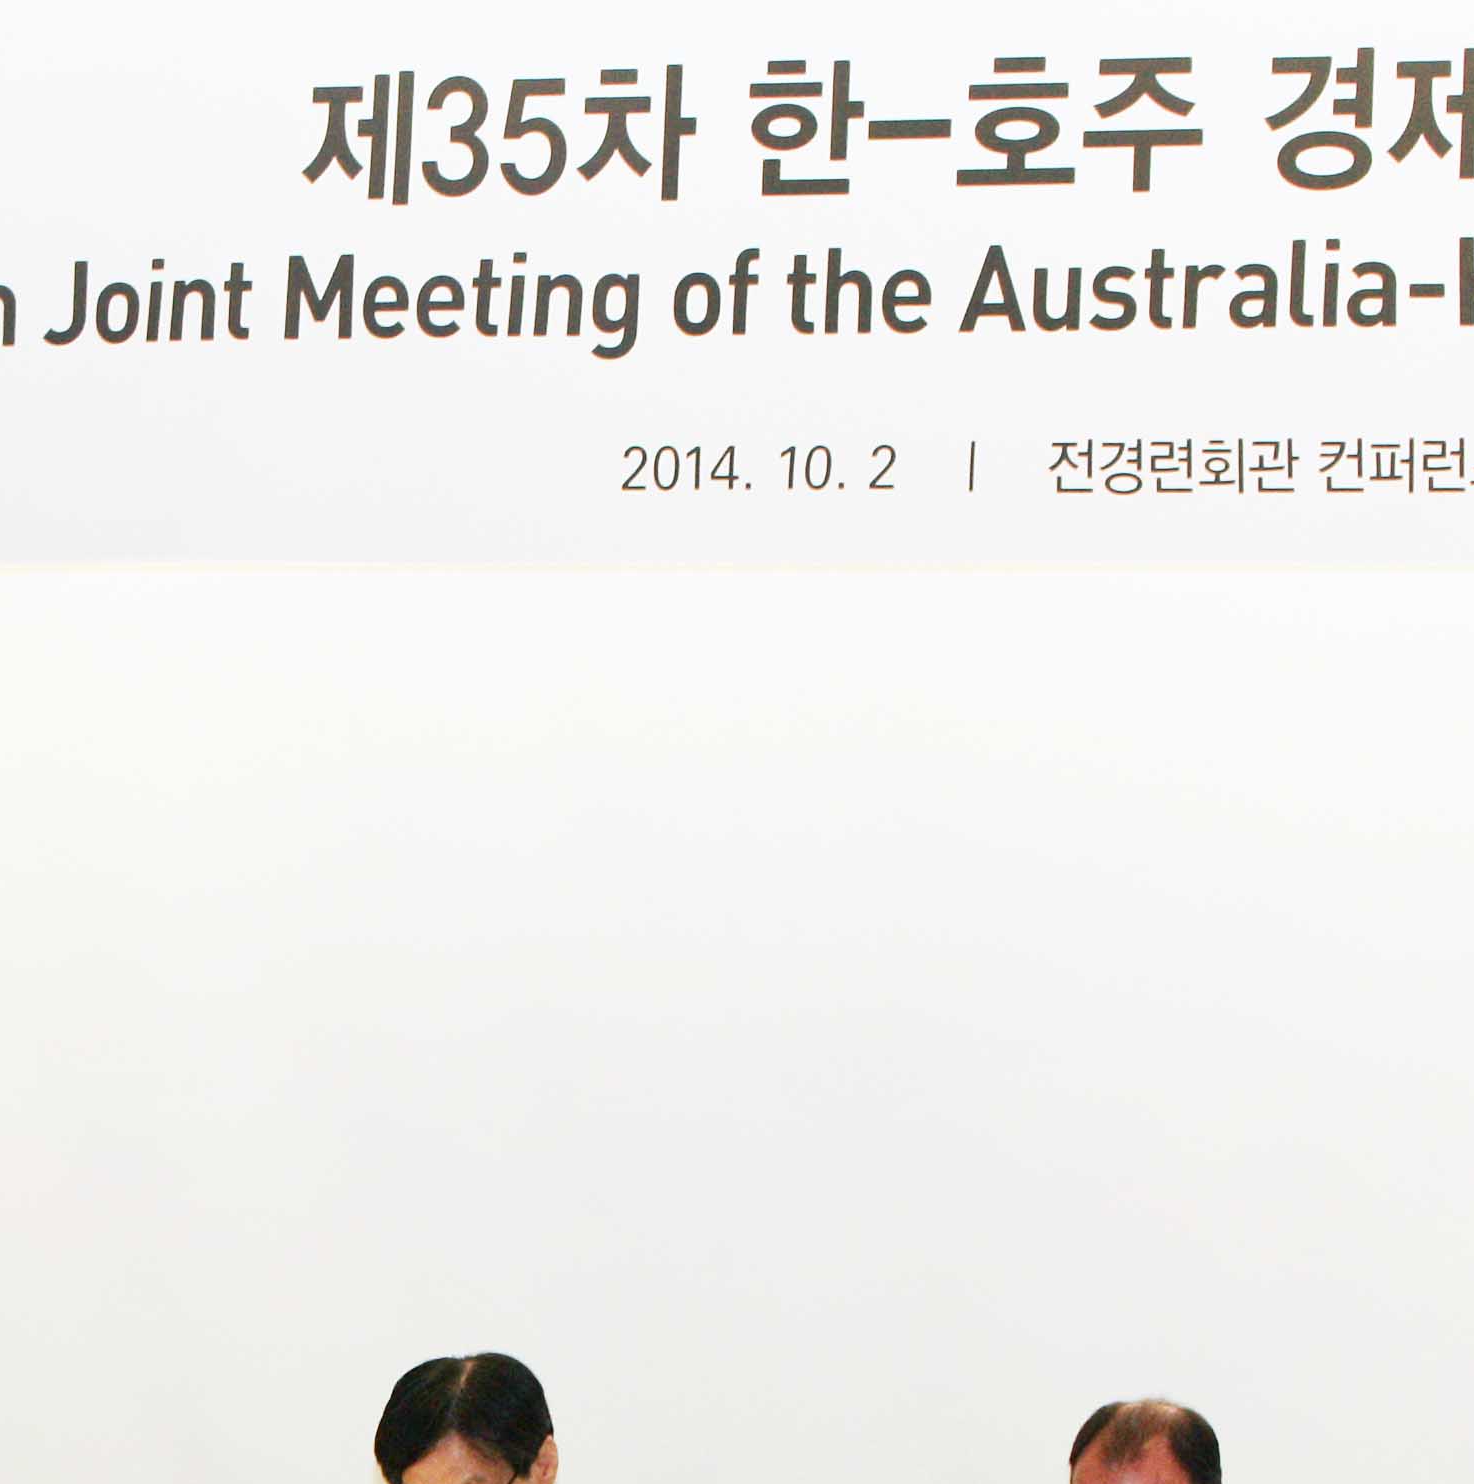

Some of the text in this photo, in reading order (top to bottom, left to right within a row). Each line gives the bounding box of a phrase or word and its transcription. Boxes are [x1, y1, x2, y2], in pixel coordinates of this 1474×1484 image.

[302, 64, 697, 206] 제35차
[749, 56, 1203, 196] 한-호주
[43, 258, 253, 346] Joint
[284, 252, 640, 360] Meeting
[673, 247, 760, 336] of
[786, 247, 932, 335] the
[621, 445, 752, 491] 2014.
[780, 445, 845, 490] 10.
[869, 444, 897, 490] 2
[1048, 438, 1300, 495] 전경련회관
